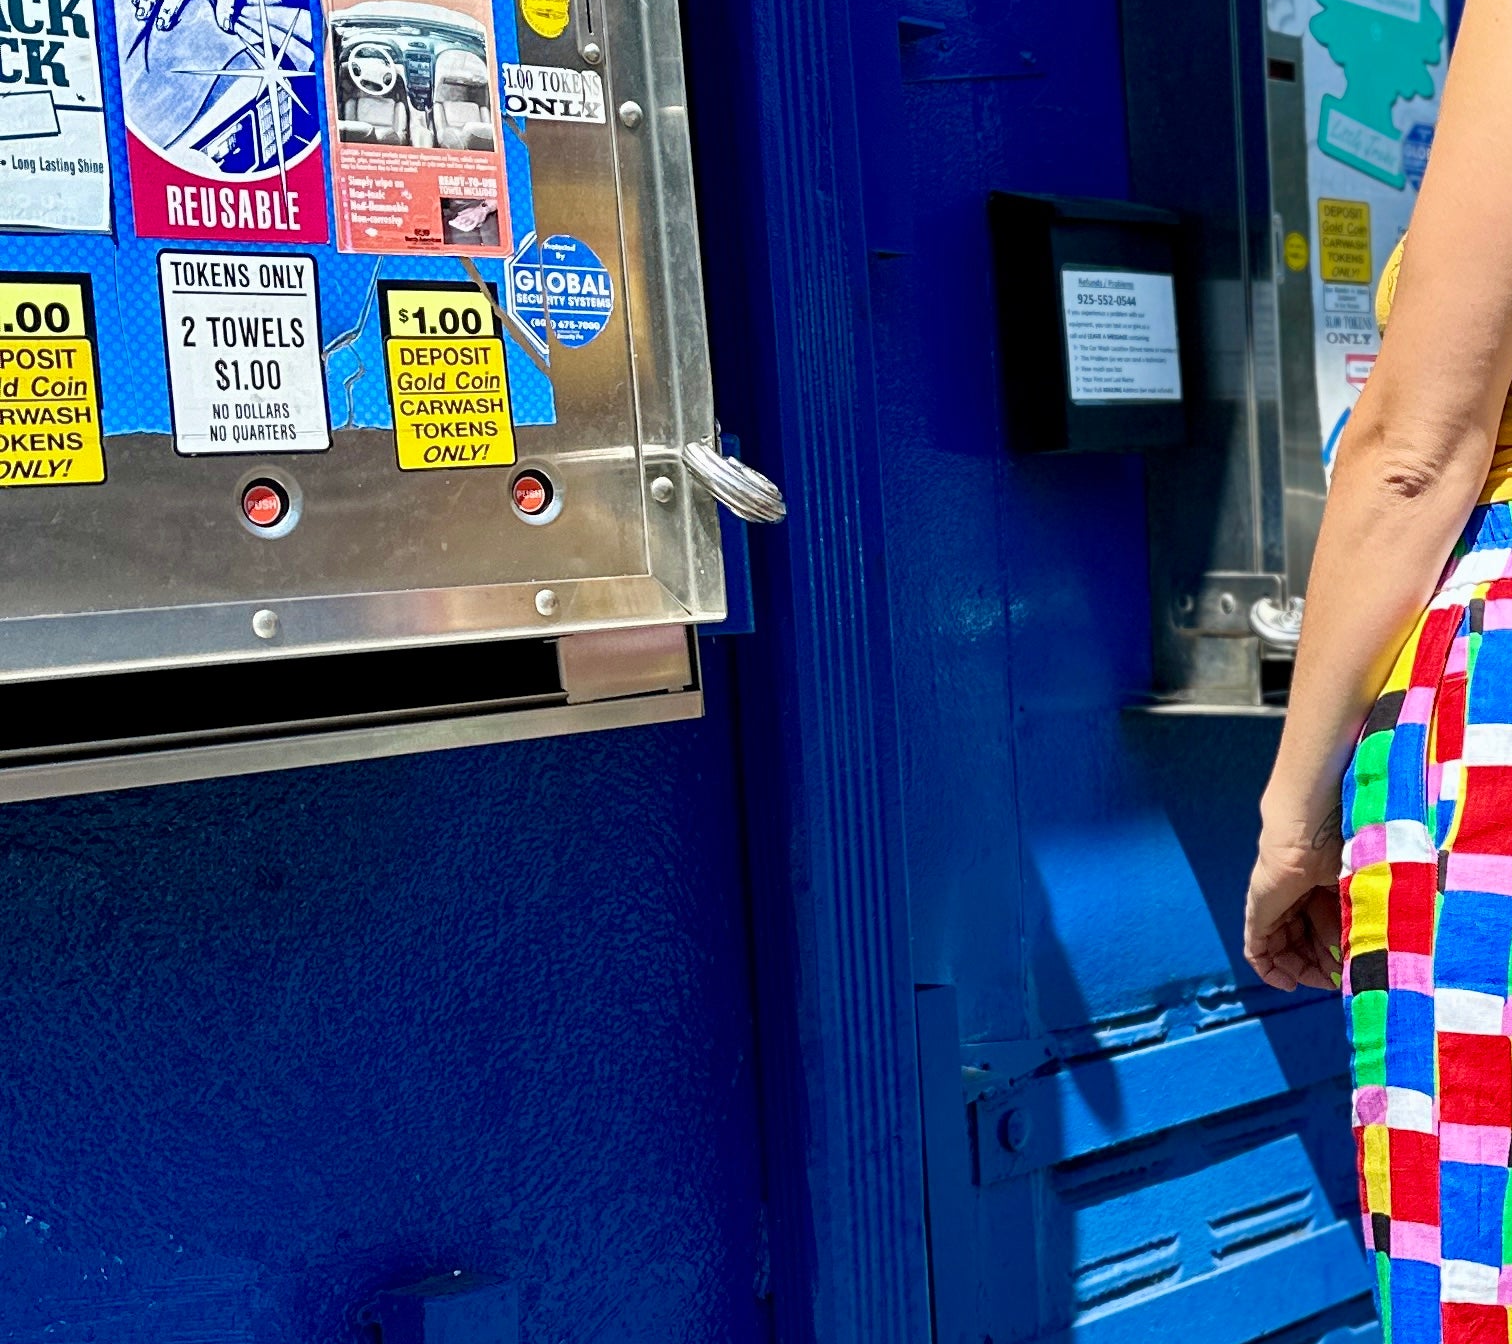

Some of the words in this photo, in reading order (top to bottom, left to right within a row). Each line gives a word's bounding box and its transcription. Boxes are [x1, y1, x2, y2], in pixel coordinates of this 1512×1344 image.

[502, 67, 534, 91] 1.00
[539, 70, 601, 96] TOKENS
[505, 94, 602, 118] ONLY
[12, 154, 36, 174] Long
[39, 156, 75, 176] Lasting
[78, 158, 104, 174] Shine
[166, 184, 300, 231] REUSABLE
[170, 261, 250, 288] TOKENS
[259, 264, 305, 289] ONLY
[568, 294, 613, 309] SYSTEMS
[1077, 293, 1137, 307] 925-552-0544
[398, 306, 482, 335] $1.00
[181, 315, 196, 347] 2
[206, 316, 305, 348] TOWELS
[1326, 331, 1373, 345] ONLY
[0, 348, 77, 370] POSIT
[400, 347, 491, 366] DEPOSIT
[214, 358, 281, 391] $1.00
[397, 372, 446, 391] Gold
[456, 371, 500, 390] Coin
[0, 376, 19, 397] d
[31, 376, 88, 397] Coin
[0, 406, 91, 425] RWASH
[212, 403, 230, 419] NO
[235, 403, 290, 419] DOLLARS
[400, 398, 504, 416] CARWASH
[210, 425, 227, 442] NO
[232, 424, 297, 443] QUARTERS
[411, 421, 498, 439] TOKENS
[423, 444, 490, 463] ONLY!
[247, 499, 277, 511] PUSH
